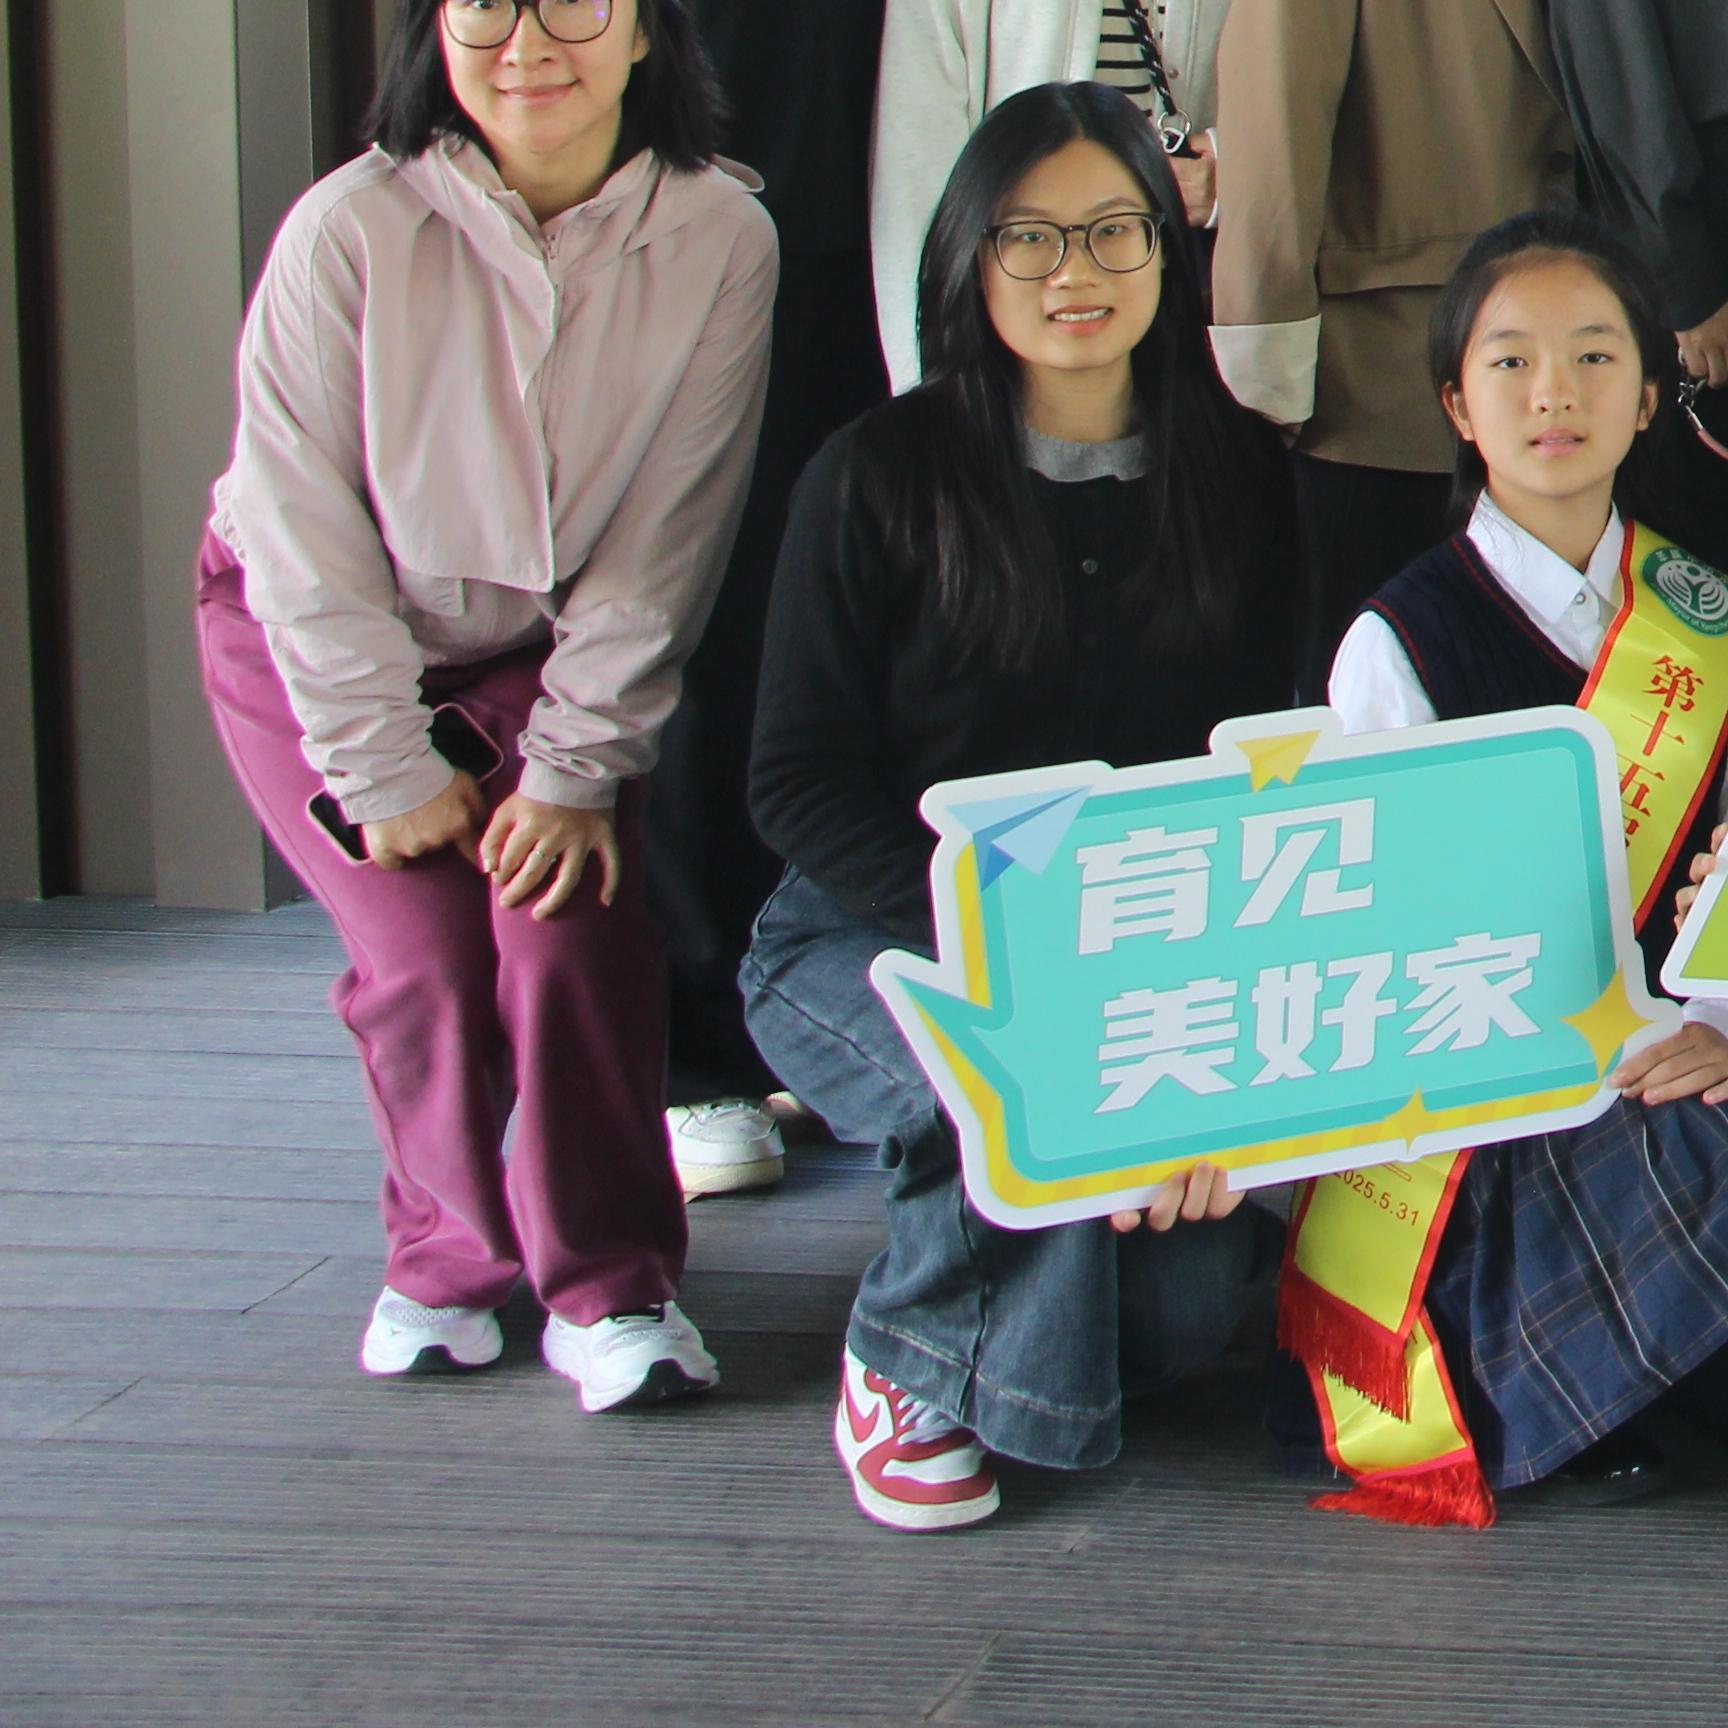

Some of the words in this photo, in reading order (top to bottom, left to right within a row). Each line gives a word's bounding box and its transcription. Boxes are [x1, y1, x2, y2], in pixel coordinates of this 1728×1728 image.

[1616, 655, 1704, 849] 第十五
[1074, 797, 1376, 955] 育见
[1093, 932, 1544, 1114] 美好家
